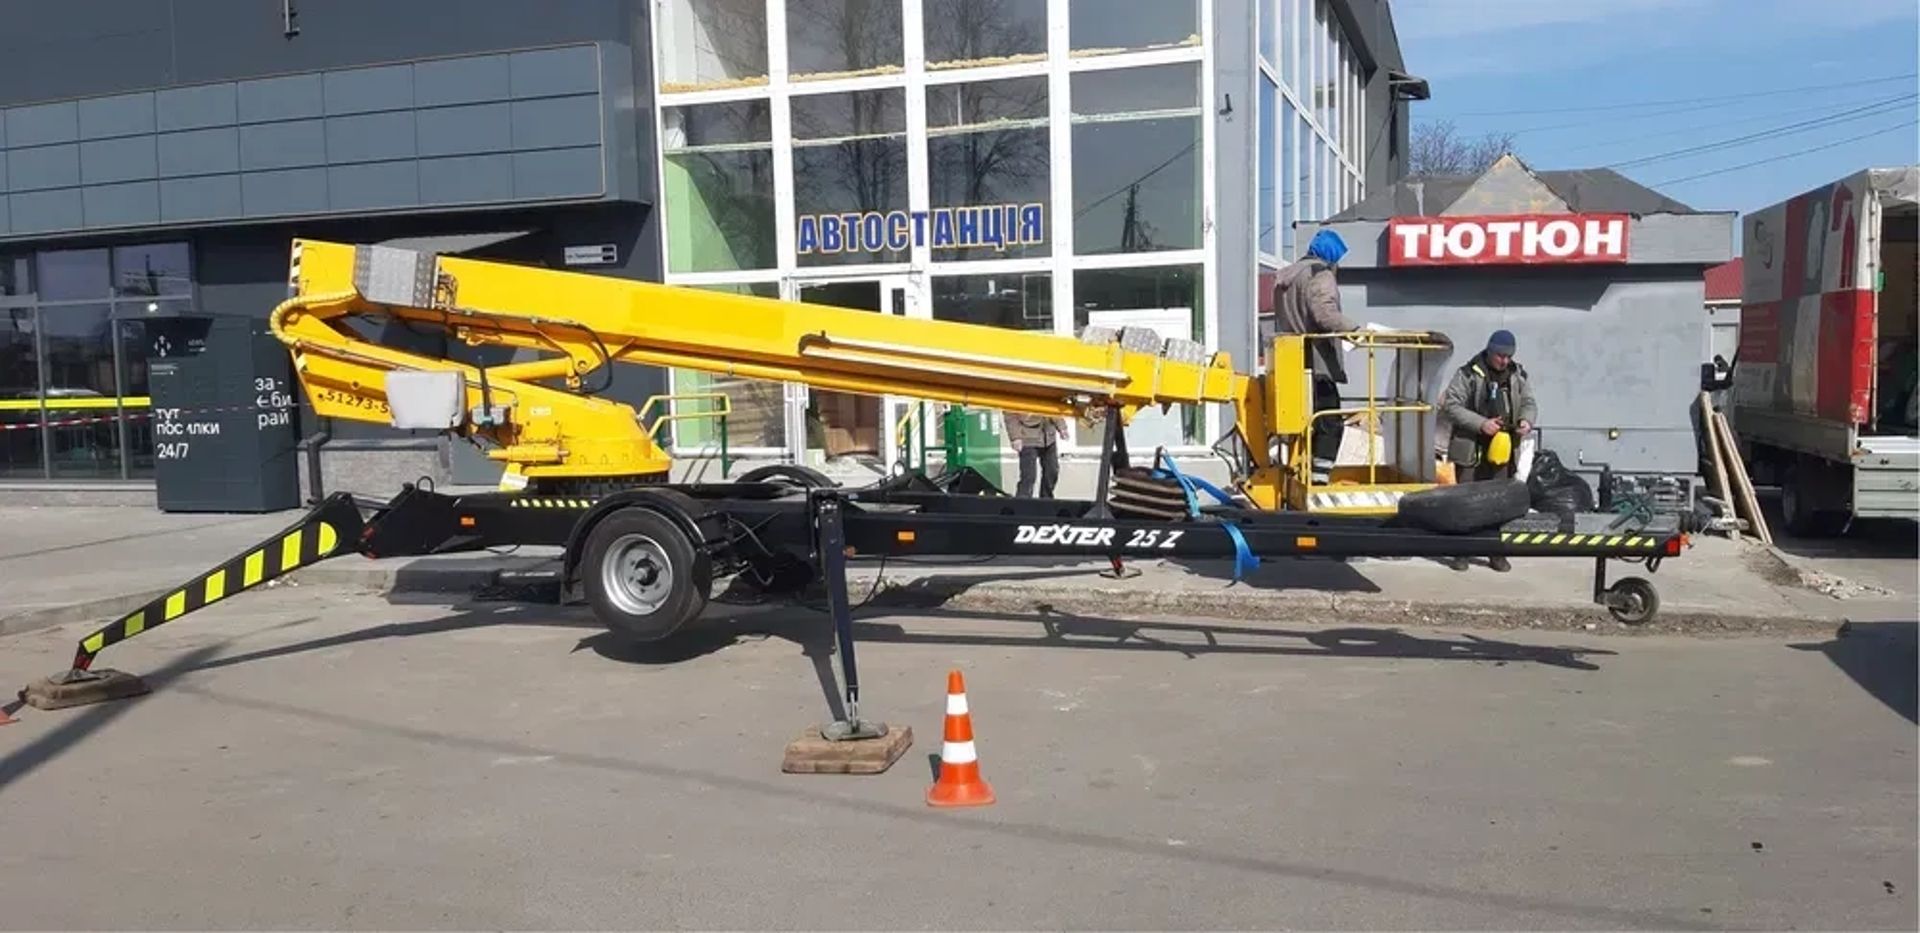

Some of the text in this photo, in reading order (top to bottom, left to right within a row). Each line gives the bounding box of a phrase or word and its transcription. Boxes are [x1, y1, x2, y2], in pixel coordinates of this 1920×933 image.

[797, 203, 1044, 254] АВТОСТАНЦІЯ
[1395, 220, 1624, 259] ТЮТЮН
[258, 408, 289, 430] рай
[157, 442, 189, 459] 24/7
[1014, 524, 1184, 548] DEXTER 25 Z
